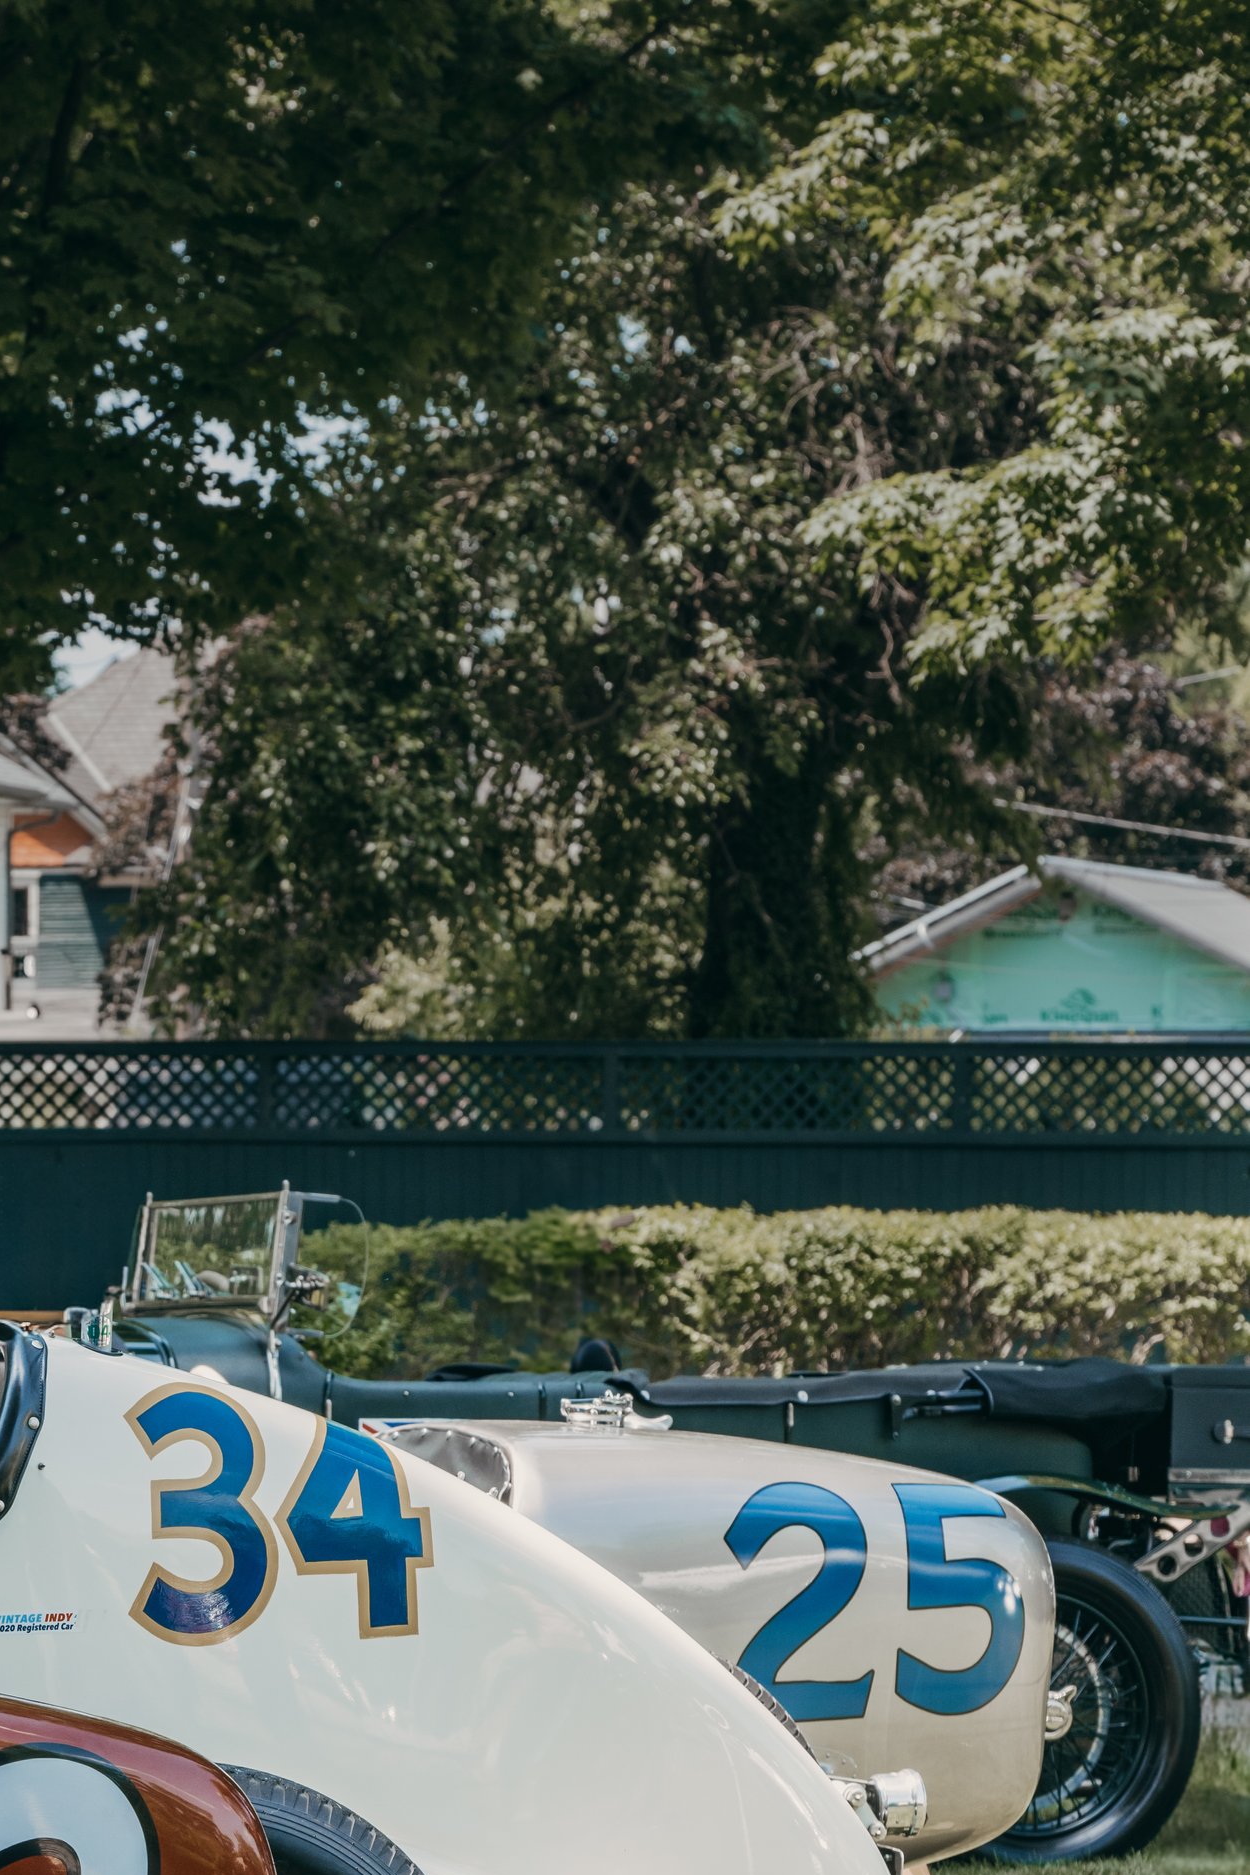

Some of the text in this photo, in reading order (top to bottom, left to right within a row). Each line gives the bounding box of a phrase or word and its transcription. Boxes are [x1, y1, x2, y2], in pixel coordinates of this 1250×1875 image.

[124, 1382, 434, 1646] 34
[16, 1622, 60, 1634] Registered
[60, 1622, 74, 1631] Car
[44, 1612, 74, 1623] INDY
[724, 1481, 1025, 1723] 25
